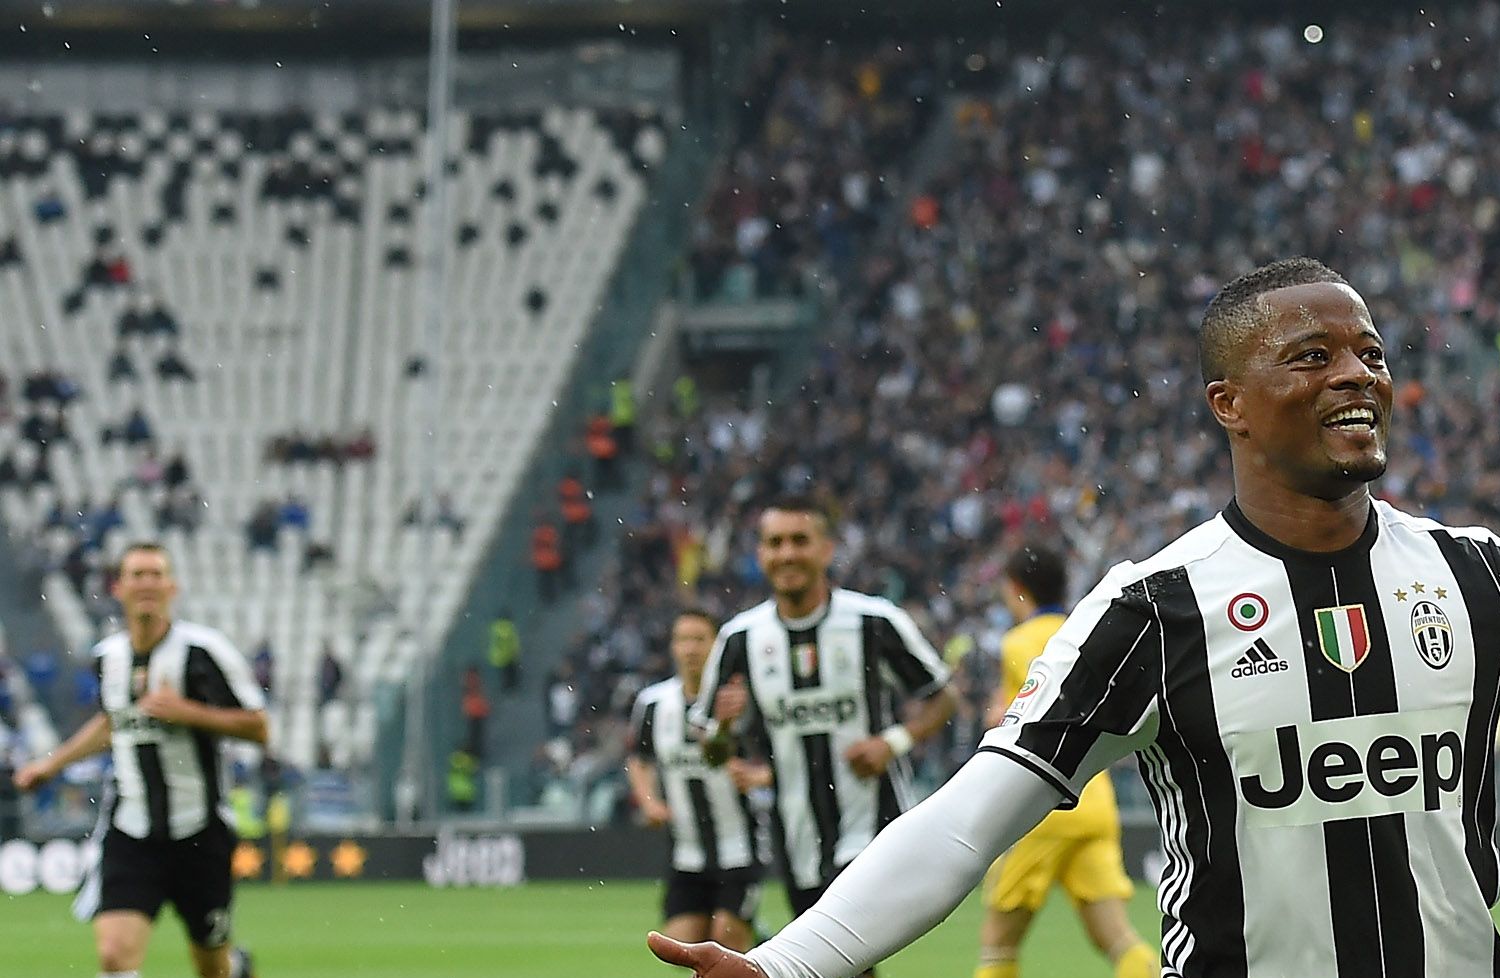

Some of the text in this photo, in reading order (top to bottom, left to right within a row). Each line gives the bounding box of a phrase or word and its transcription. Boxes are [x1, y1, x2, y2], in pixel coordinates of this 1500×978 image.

[1414, 615, 1447, 627] JUVENTUS
[1231, 660, 1289, 679] adidas
[1239, 724, 1463, 812] Jeep
